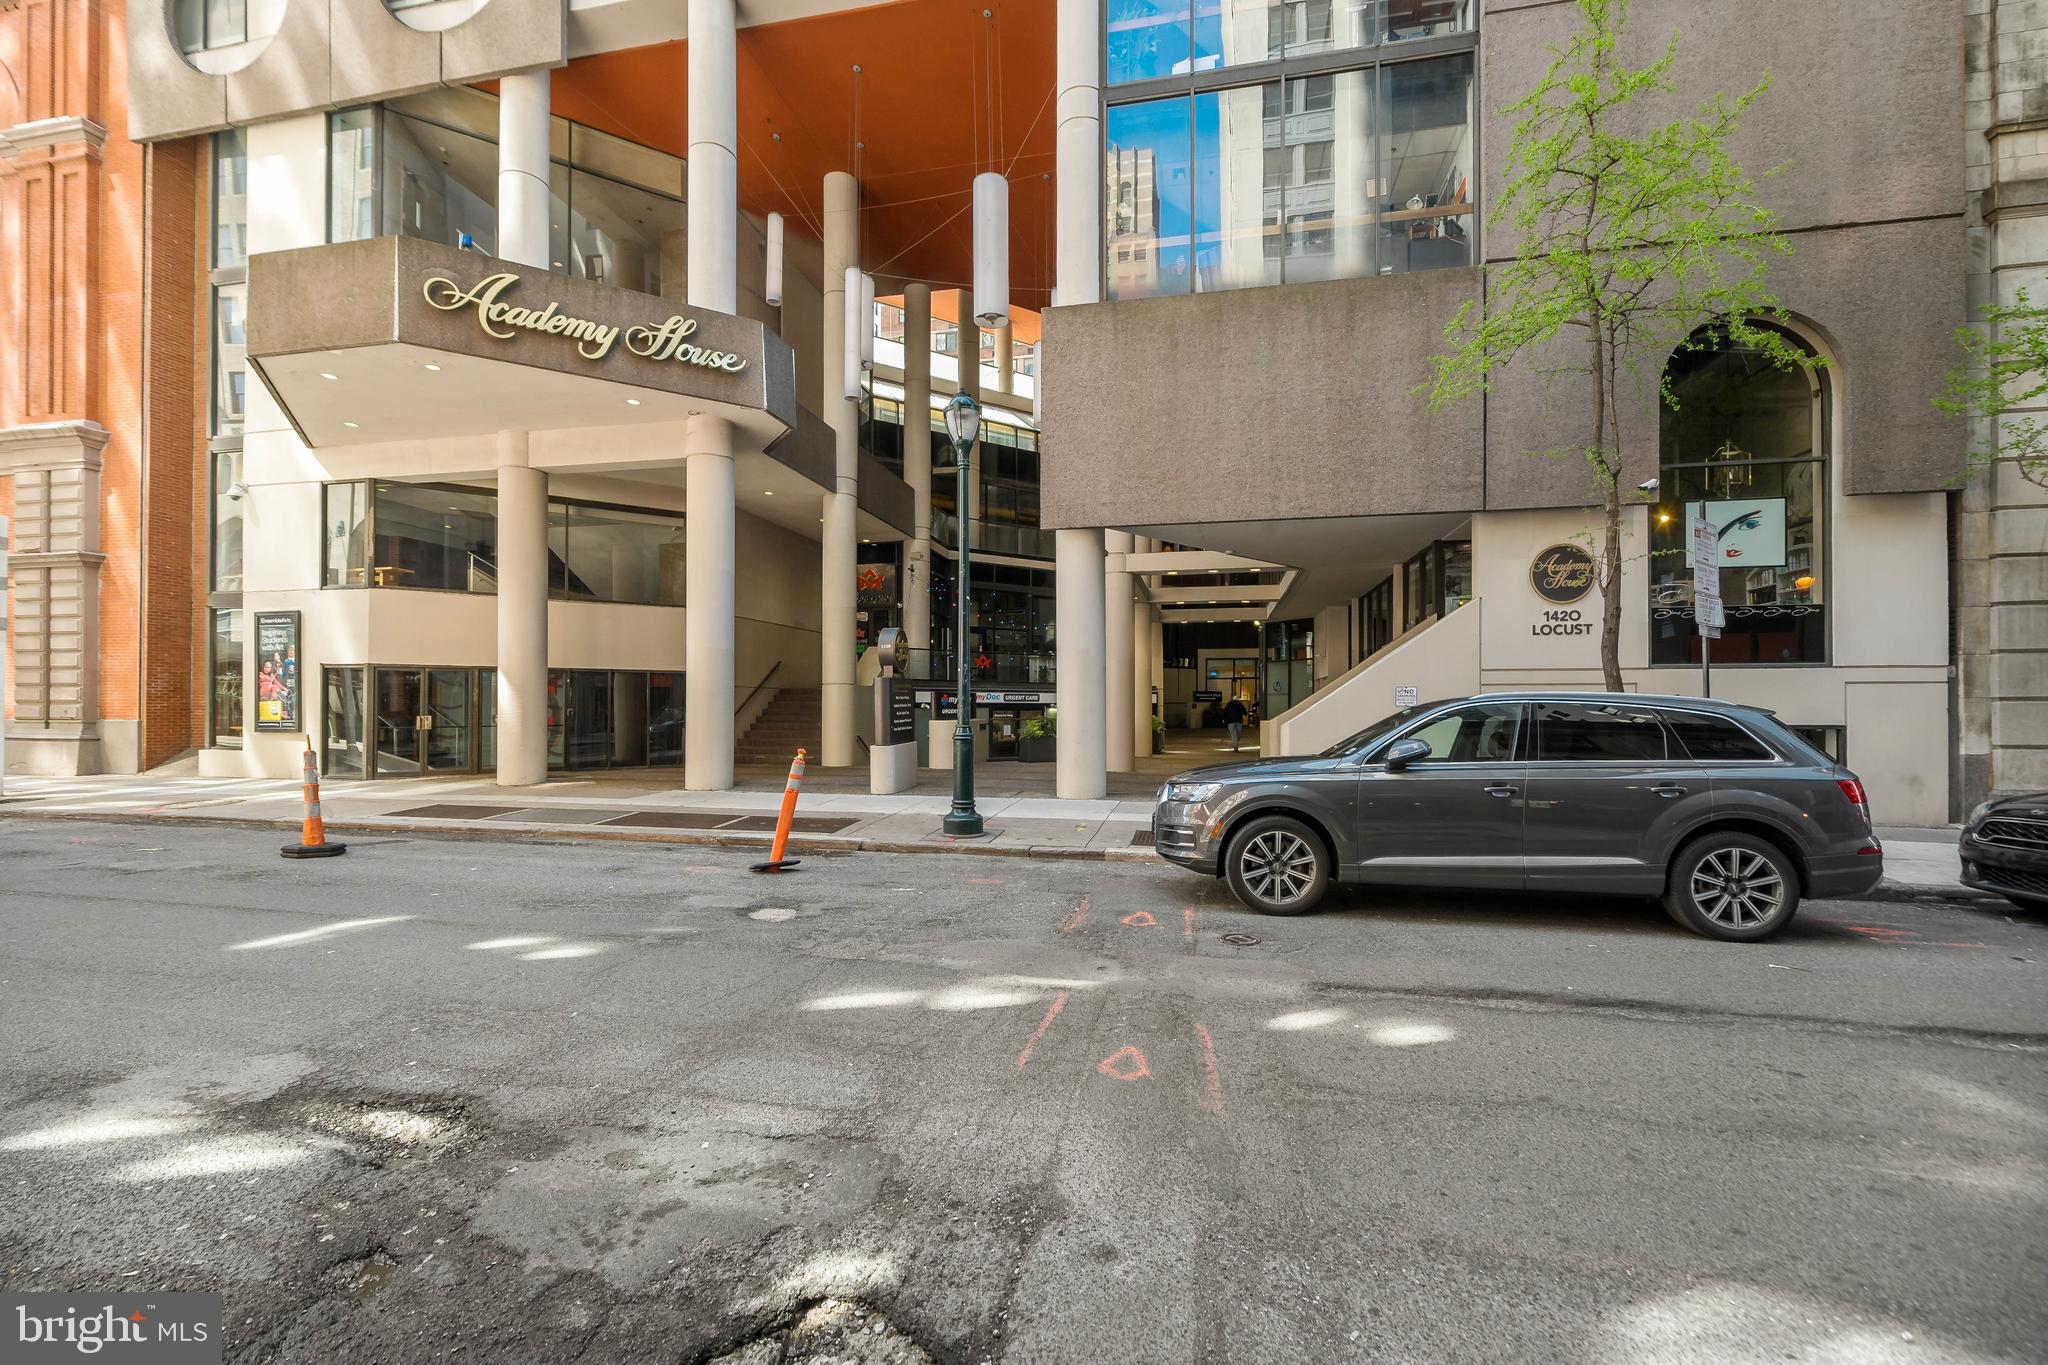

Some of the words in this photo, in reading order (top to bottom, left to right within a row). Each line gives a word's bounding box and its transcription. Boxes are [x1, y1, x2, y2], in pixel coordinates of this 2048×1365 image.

[423, 273, 619, 360] Academy
[625, 315, 746, 373] House
[1532, 554, 1594, 577] Academy
[1543, 610, 1581, 621] 1420
[1532, 624, 1593, 636] LOCUST
[976, 693, 1001, 701] myDoc
